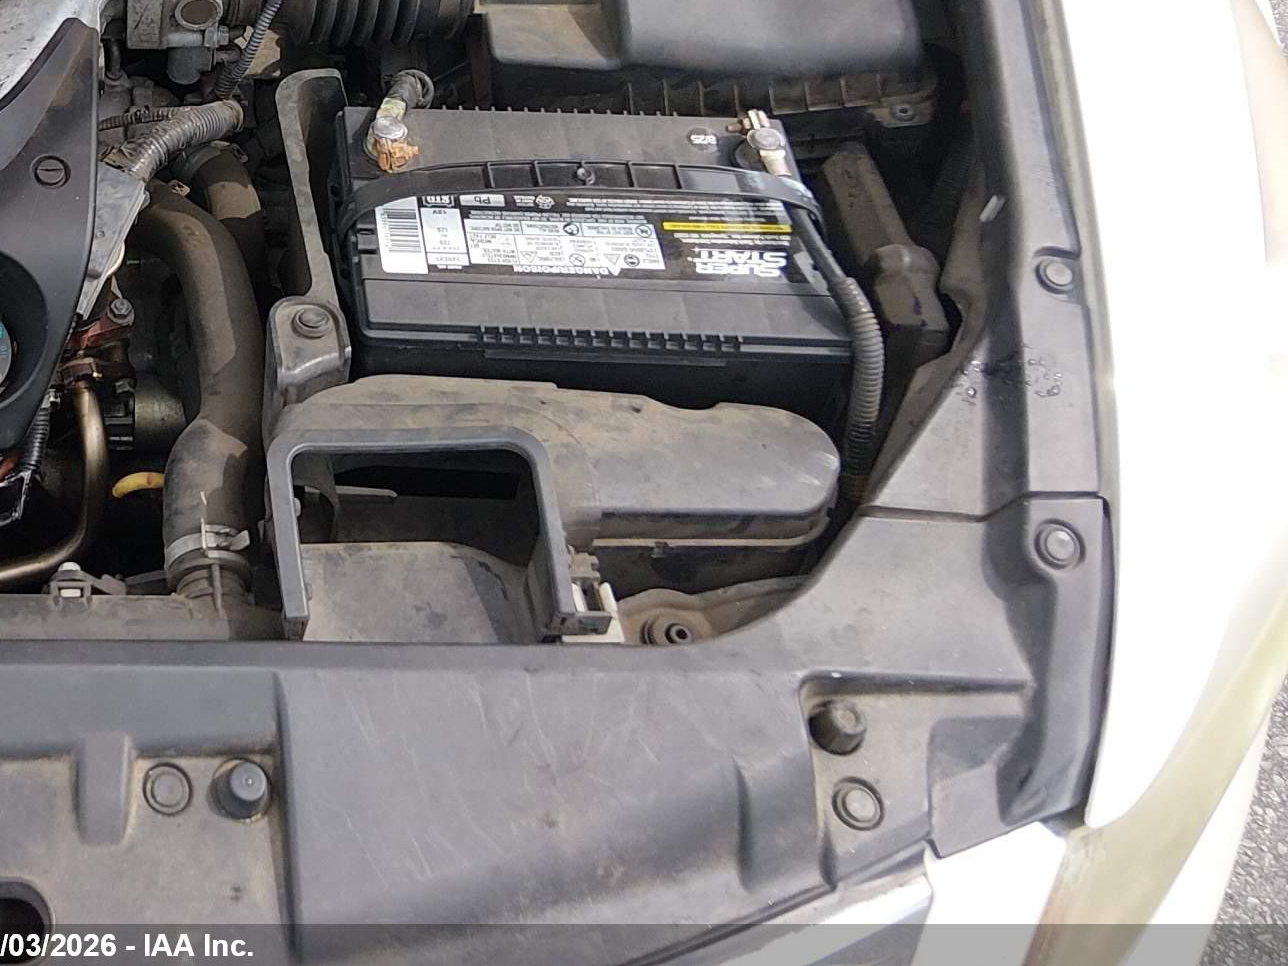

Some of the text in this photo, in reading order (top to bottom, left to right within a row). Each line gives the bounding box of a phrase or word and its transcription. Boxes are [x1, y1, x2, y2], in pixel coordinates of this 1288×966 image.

[474, 196, 492, 205] Pb
[693, 250, 788, 267] START
[695, 262, 781, 277] SUPER
